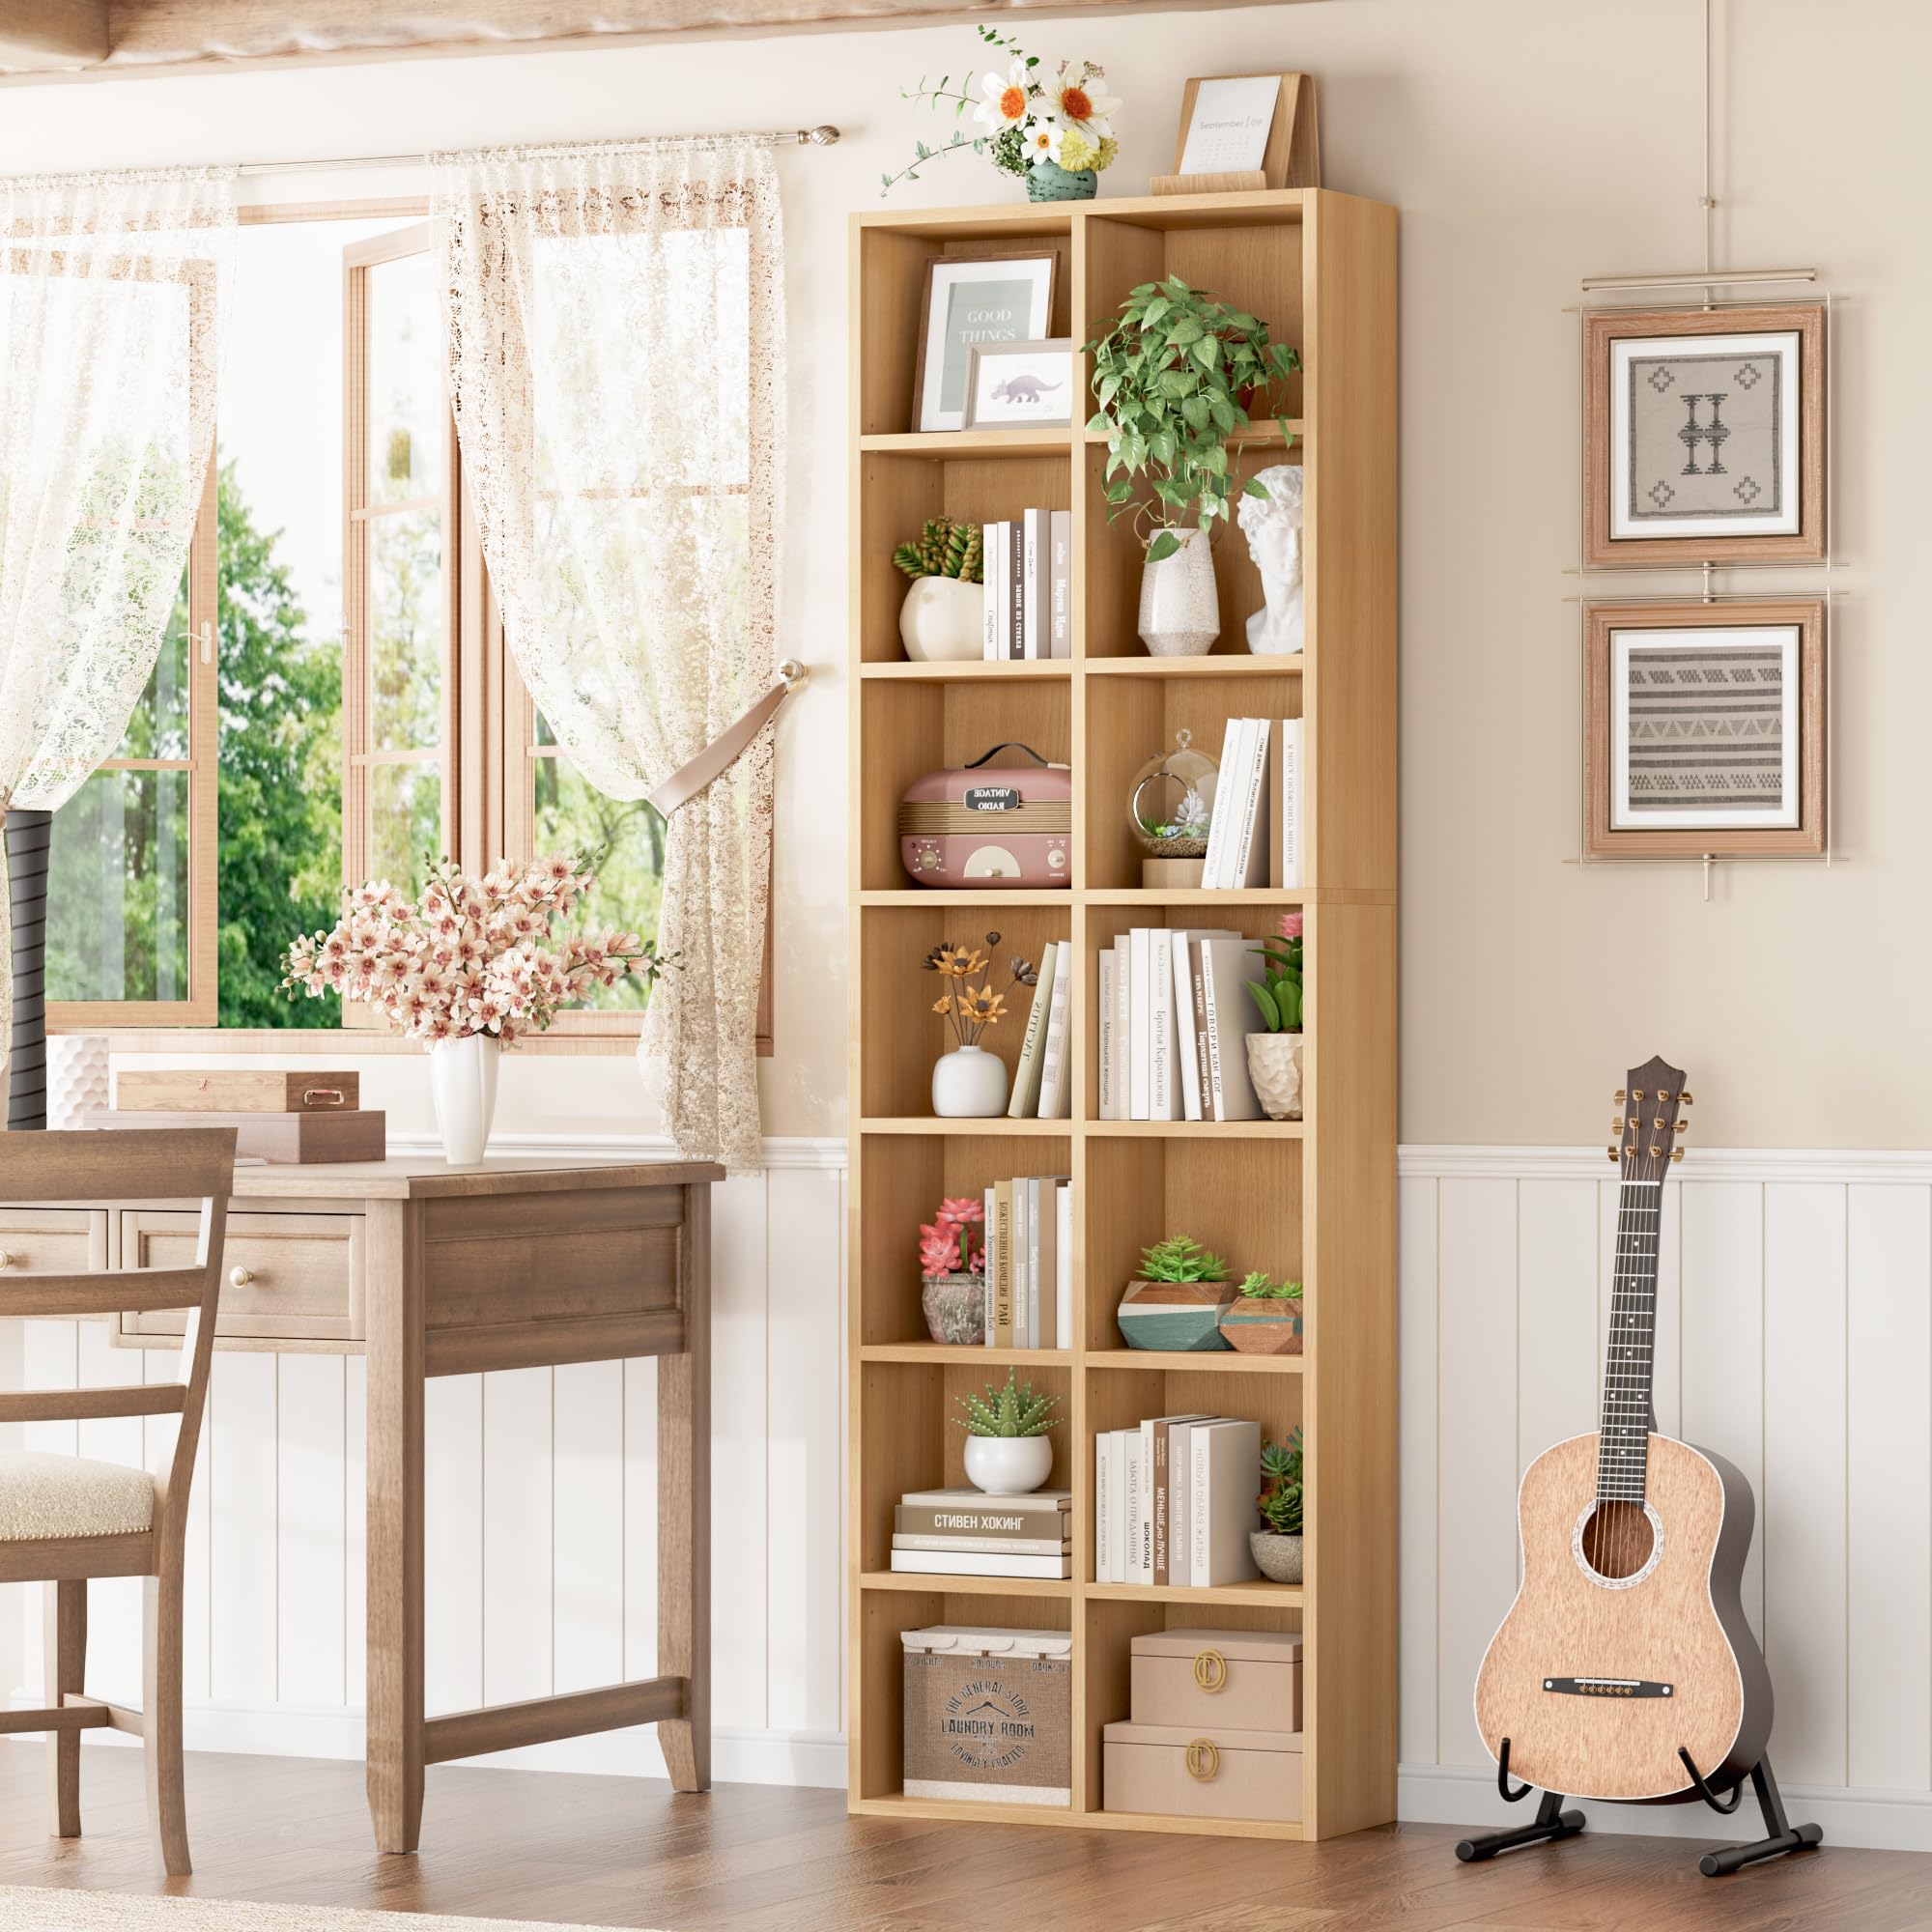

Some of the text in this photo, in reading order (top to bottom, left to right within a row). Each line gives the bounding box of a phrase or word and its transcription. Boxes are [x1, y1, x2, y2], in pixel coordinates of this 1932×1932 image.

[967, 308, 1012, 324] GOOD
[959, 328, 1016, 343] THINGS
[1249, 779, 1260, 808] Религия
[1207, 1002, 1217, 1049] ГОВОРИ
[999, 1202, 1008, 1260] БОЖЕСТВЕННАЯ
[999, 1303, 1010, 1325] РАЙ
[934, 1514, 1025, 1531] СТИВЕН ХОКИНГ
[1156, 1540, 1165, 1571] ЛУЧШЕ
[945, 1680, 1031, 1718] THE GENERAL STORE
[941, 1719, 1035, 1738] LAUNDRY ROOM
[951, 1743, 988, 1770] LOVINGLY
[991, 1744, 1026, 1770] CRAFTED
